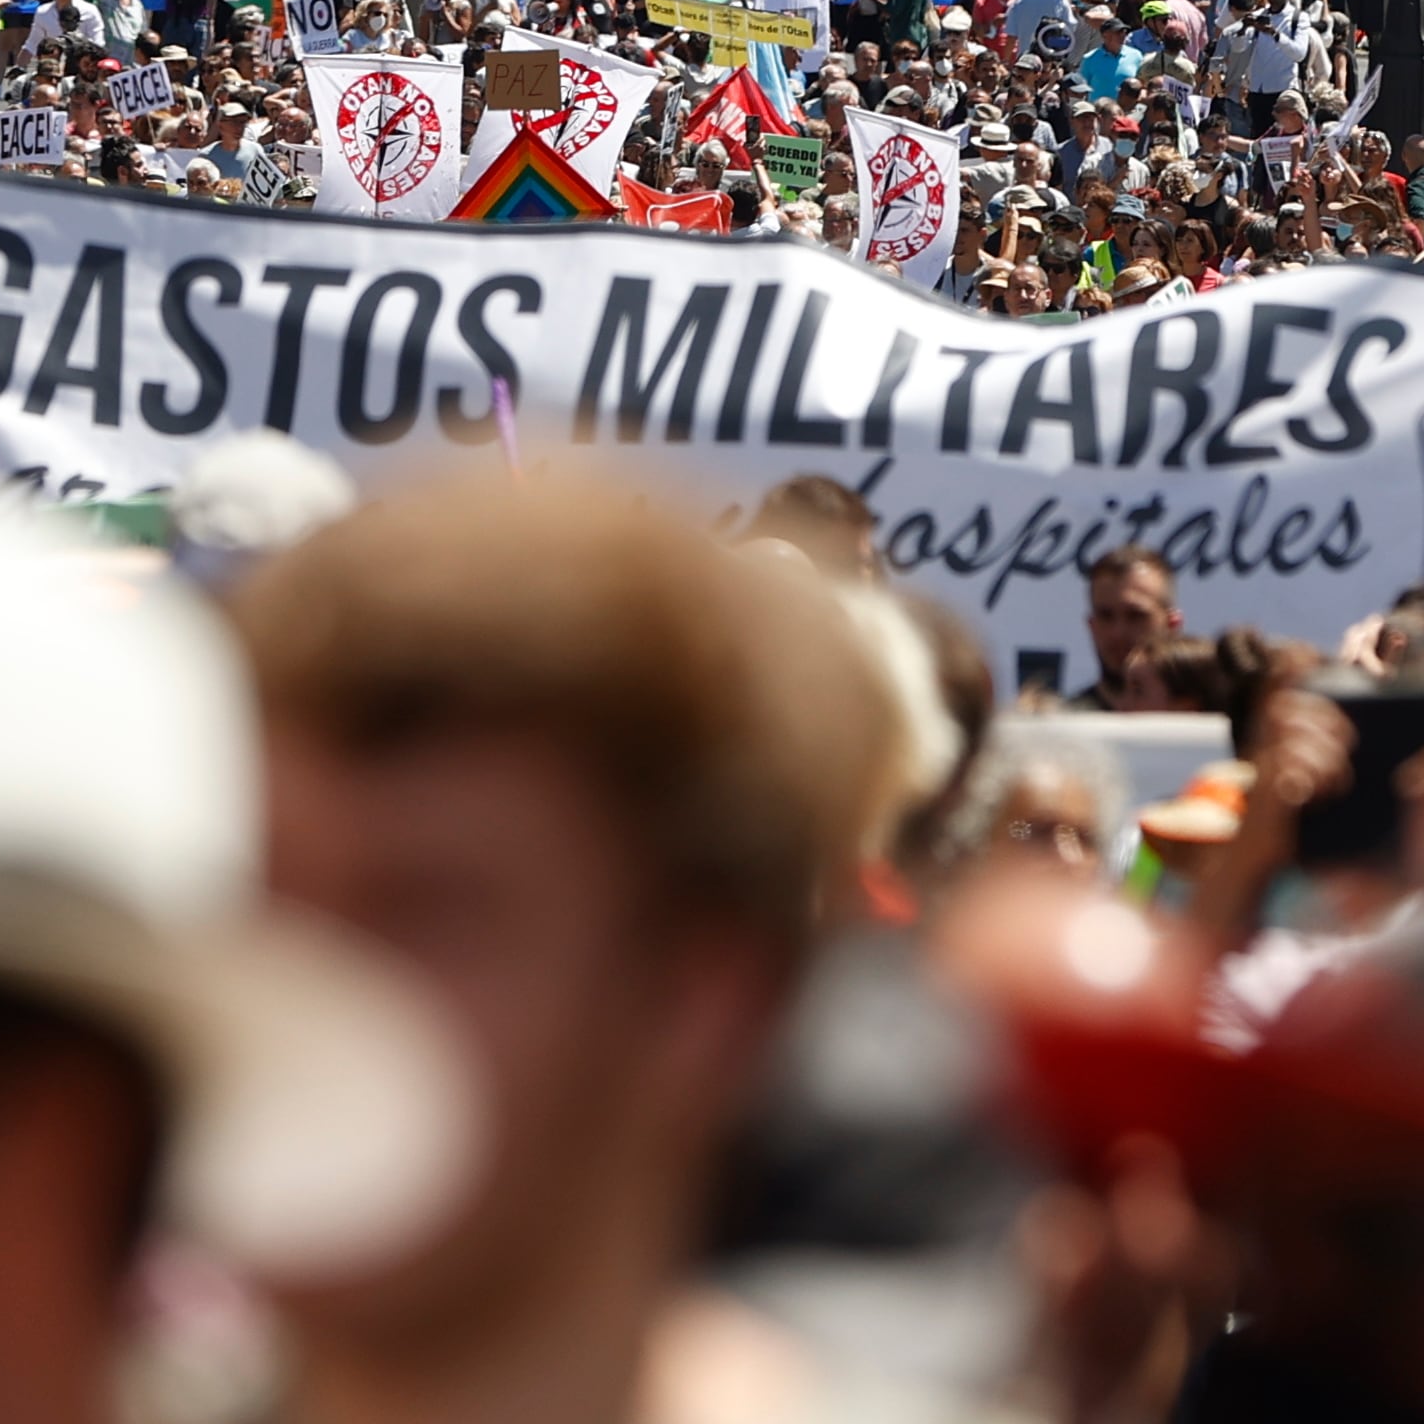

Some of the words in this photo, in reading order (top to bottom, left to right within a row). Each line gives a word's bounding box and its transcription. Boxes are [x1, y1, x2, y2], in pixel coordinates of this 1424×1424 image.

[766, 24, 779, 35] de
[111, 65, 170, 111] PEACE!
[342, 75, 393, 112] OTAN
[490, 63, 548, 97] PAZ
[588, 81, 615, 106] NO
[401, 85, 432, 117] NO
[556, 109, 613, 159] BASE
[382, 135, 439, 198] BASES
[766, 144, 818, 163] CUERDO
[914, 150, 940, 188] NO
[876, 204, 943, 259] BASES
[570, 274, 1409, 470] MILITARES
